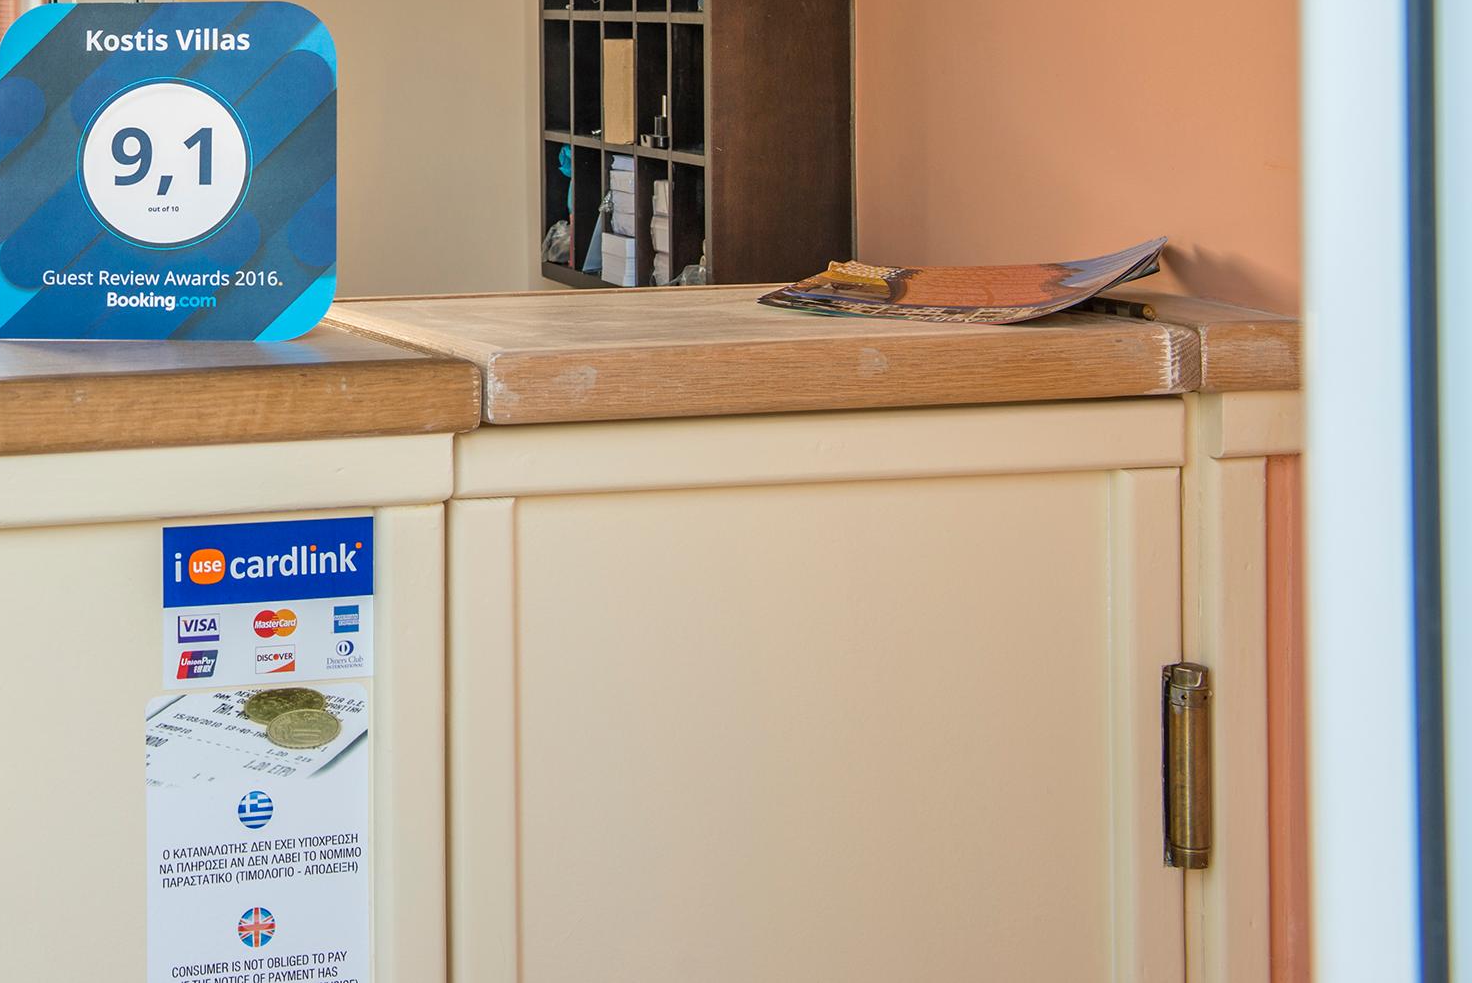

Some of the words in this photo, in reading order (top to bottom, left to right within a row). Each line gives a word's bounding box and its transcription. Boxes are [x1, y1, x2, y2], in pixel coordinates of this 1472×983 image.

[86, 30, 168, 52] Kostis
[176, 29, 250, 51] Villas
[111, 127, 213, 196] 9,1
[43, 270, 93, 286] Guest
[99, 270, 159, 286] Review
[164, 270, 230, 286] Awards
[107, 292, 216, 310] Booking.com
[175, 553, 181, 582] i
[193, 559, 222, 574] use
[230, 543, 357, 579] cardlink
[183, 618, 217, 632] VISA
[255, 619, 296, 629] MasterCard
[181, 656, 215, 668] UnionPay
[257, 653, 293, 661] DISCOVER
[326, 657, 347, 666] Diners
[348, 655, 364, 664] Club
[173, 843, 248, 859] ΚΑΤΑΝΑΛΩΤΗΣ
[251, 841, 271, 852] ΔΕΝ
[275, 839, 295, 850] ΕΧΕΙ
[298, 834, 358, 848] ΥΠΟΧΡΕΩΣΗ
[159, 864, 173, 874] ΝΑ
[176, 859, 227, 873] ΠΛΗΡΩΣΕΙ
[230, 857, 245, 868] ΑΝ
[248, 855, 268, 866] ΔΕΝ
[271, 853, 300, 864] ΛΑΒΕΙ
[304, 851, 316, 861] ΤΟ
[320, 847, 361, 860] ΝΟΜΙΜΟ
[162, 872, 232, 888] ΠΑΡΑΣΤΑΤΙΚΟ
[236, 867, 295, 883] (ΤΙΜΟΛΟΓΙΟ
[304, 861, 358, 875] ΑΠΟΔΕΙΞΗ)
[172, 962, 229, 978] CONSUMER
[232, 961, 241, 972] IS
[244, 959, 264, 970] NOT
[267, 955, 309, 968] OBLIGED
[312, 953, 325, 964] TO
[328, 951, 346, 962] PAY
[253, 973, 265, 983] OF
[269, 969, 315, 983] PAYMENT
[318, 966, 338, 978] HAS
